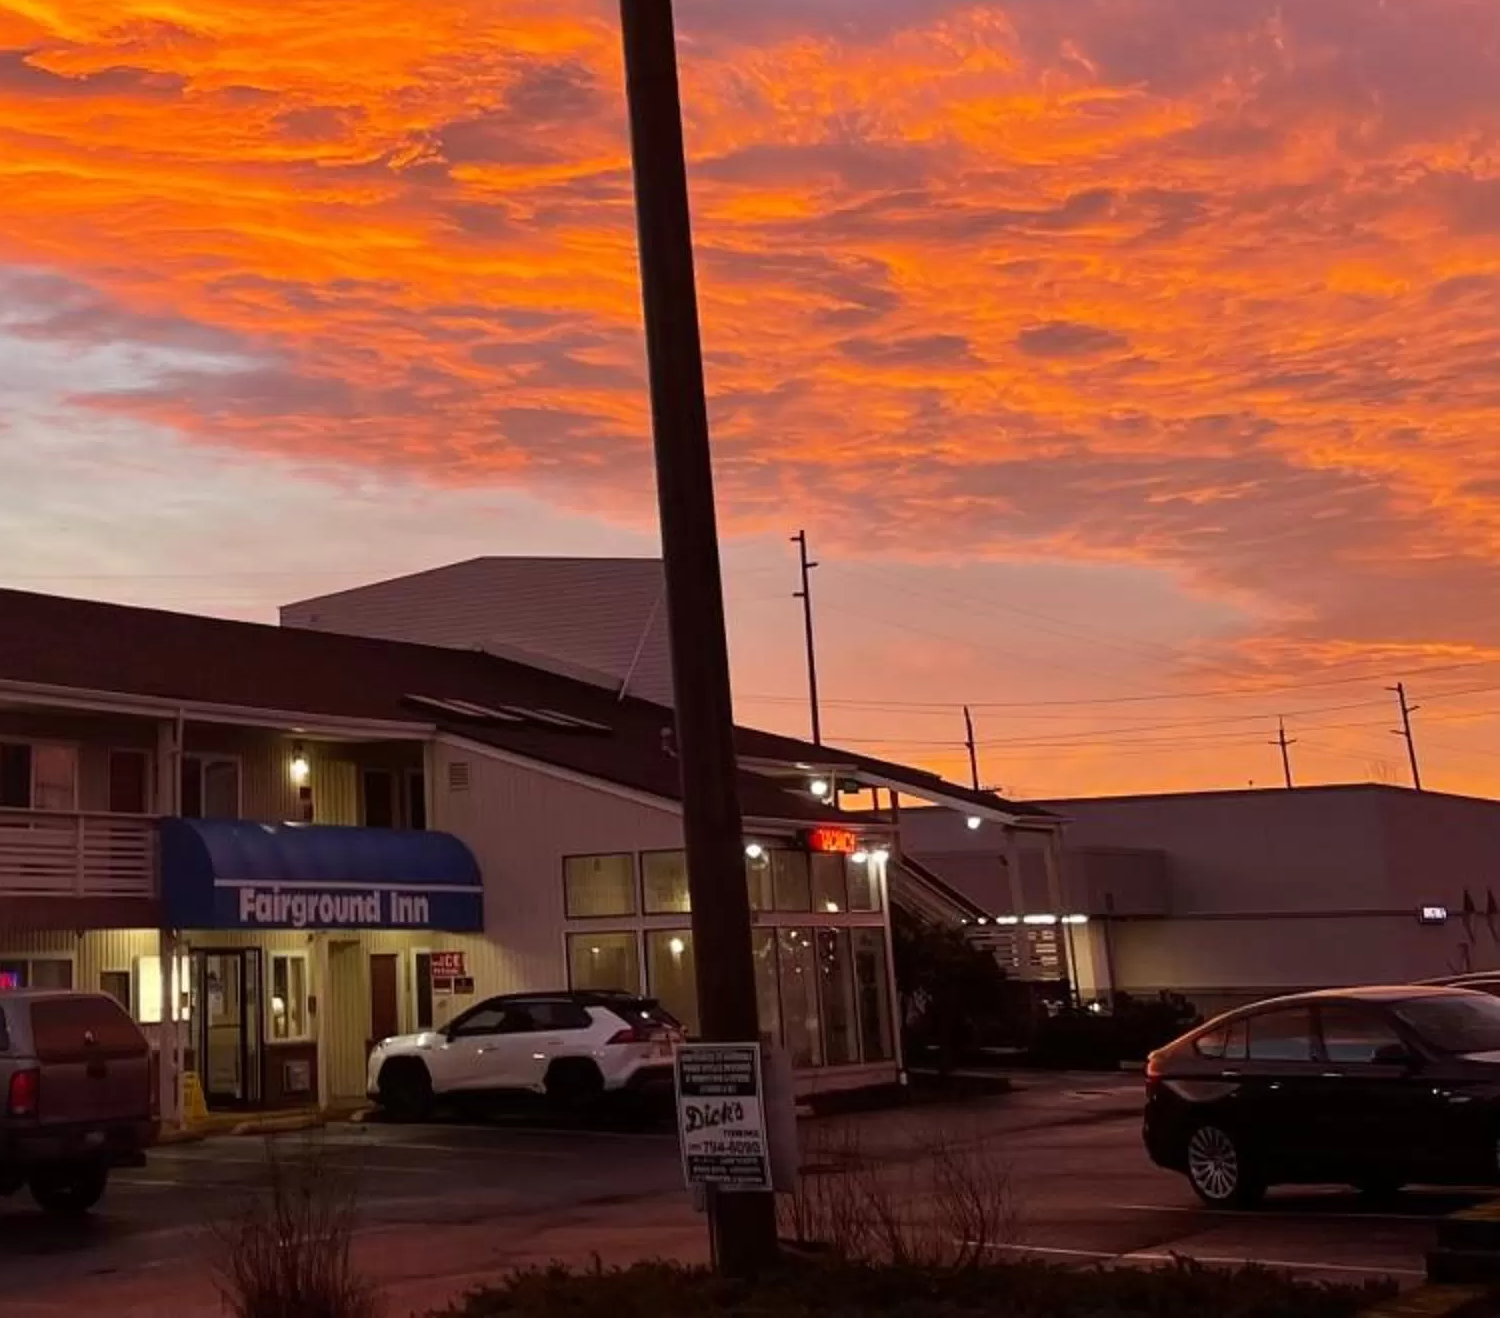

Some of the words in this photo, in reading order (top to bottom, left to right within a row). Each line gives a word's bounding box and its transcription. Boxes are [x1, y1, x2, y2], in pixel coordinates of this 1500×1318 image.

[239, 886, 381, 927] Fairground
[390, 891, 429, 923] Inn
[685, 1101, 744, 1133] Dick's
